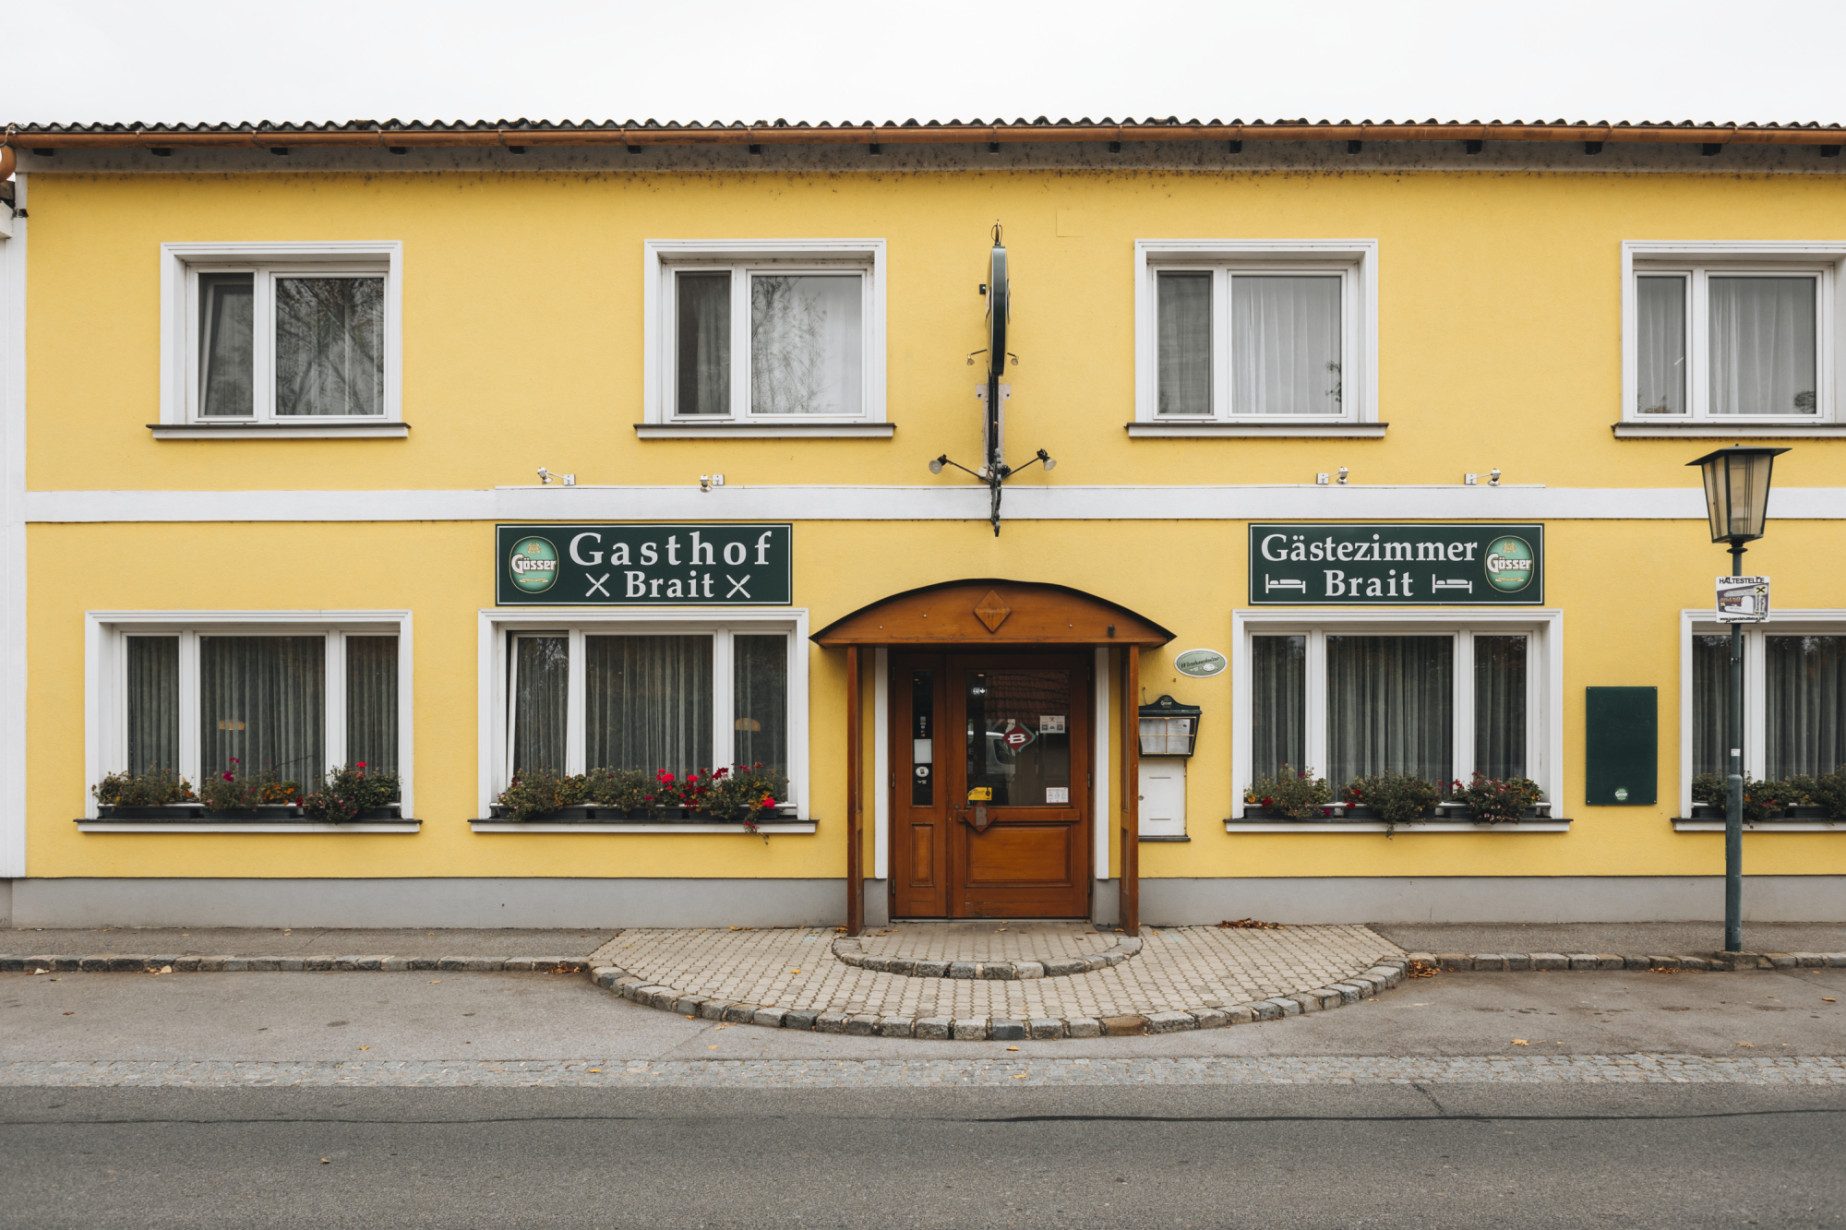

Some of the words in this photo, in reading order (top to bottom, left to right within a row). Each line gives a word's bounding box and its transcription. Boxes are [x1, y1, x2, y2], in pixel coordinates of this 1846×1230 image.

[569, 531, 772, 566] Gasthof
[1261, 534, 1478, 562] Gästezimmer
[511, 553, 556, 574] Gösser
[1487, 553, 1532, 573] Gösser
[624, 570, 715, 598] Brait
[1323, 569, 1414, 597] Brait
